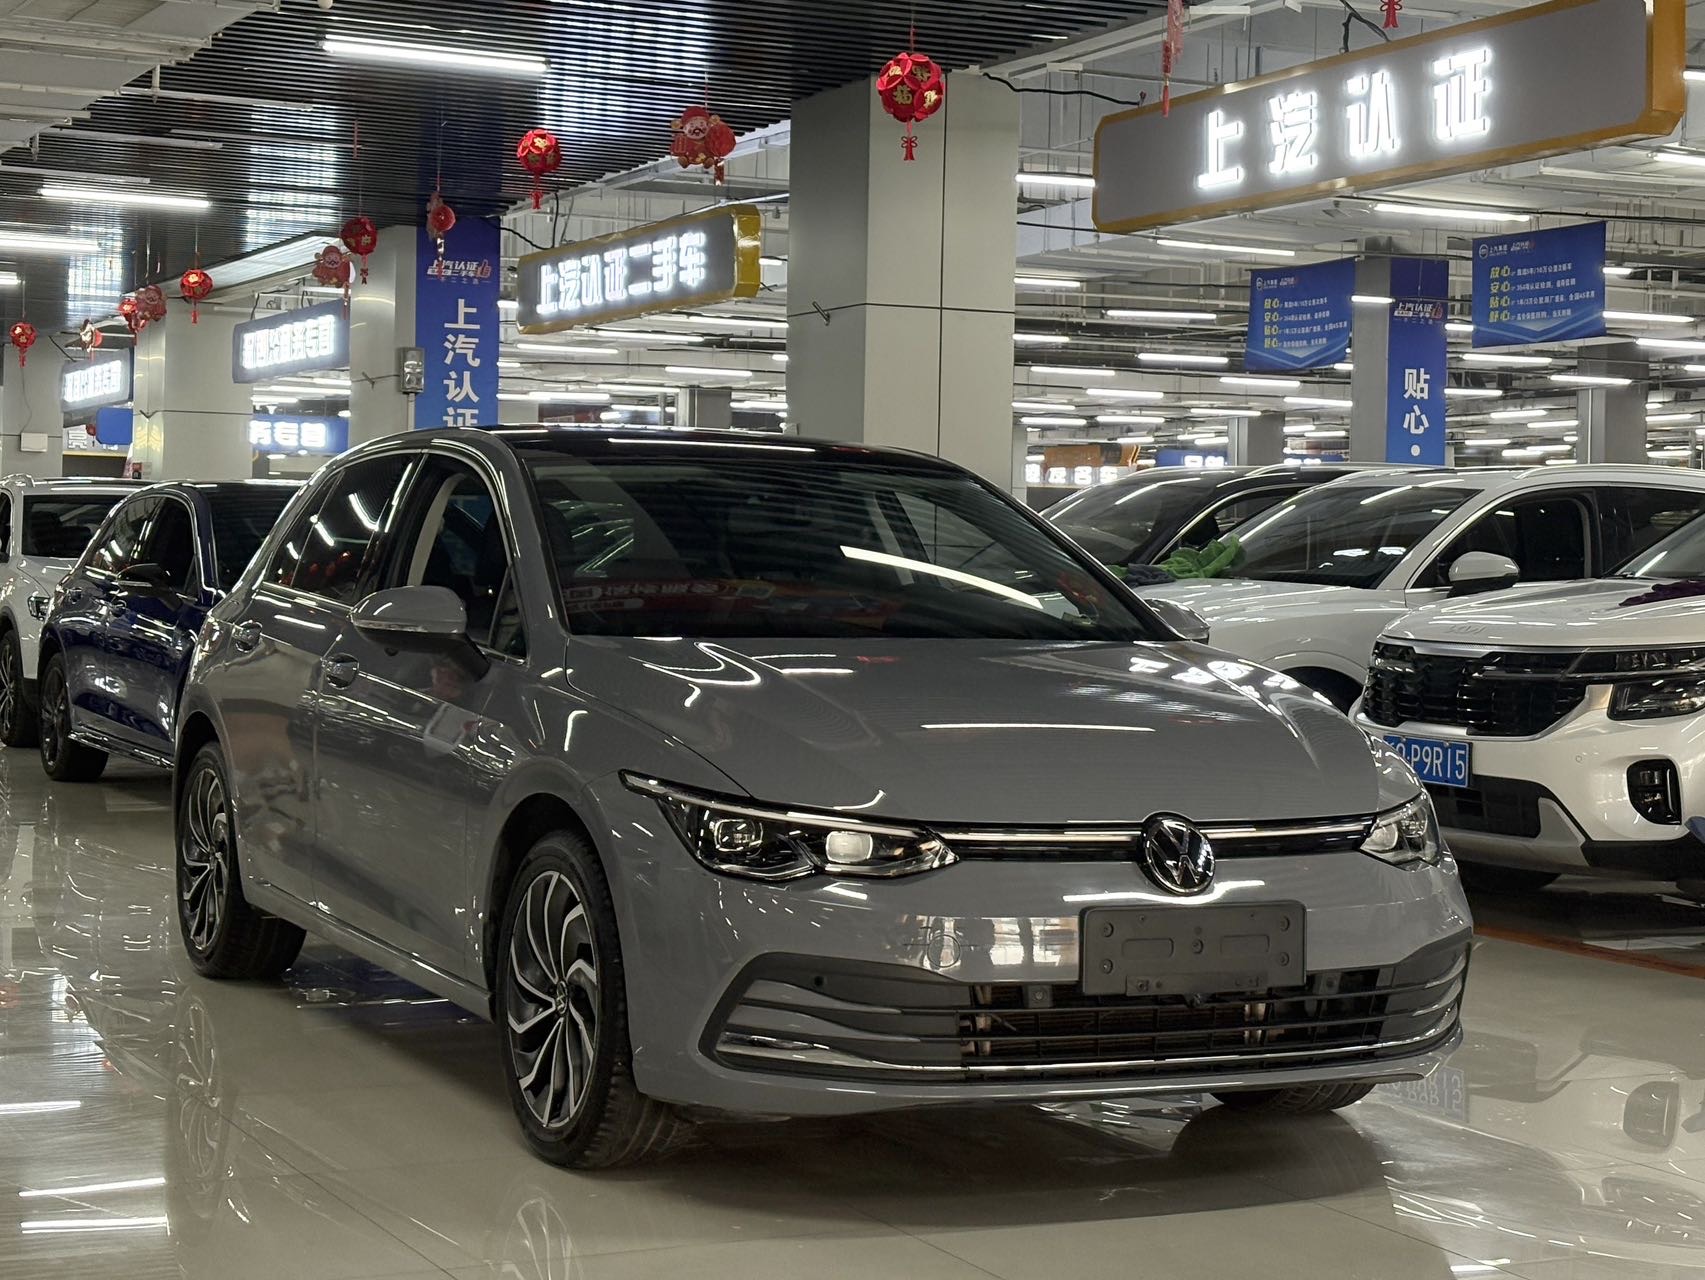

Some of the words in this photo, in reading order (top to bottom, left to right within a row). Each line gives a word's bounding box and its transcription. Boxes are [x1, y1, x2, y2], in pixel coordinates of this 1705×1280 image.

[1197, 48, 1491, 189] 上汽认证
[536, 232, 706, 314] 上汽认证二手车
[443, 298, 480, 427] 上汽认证
